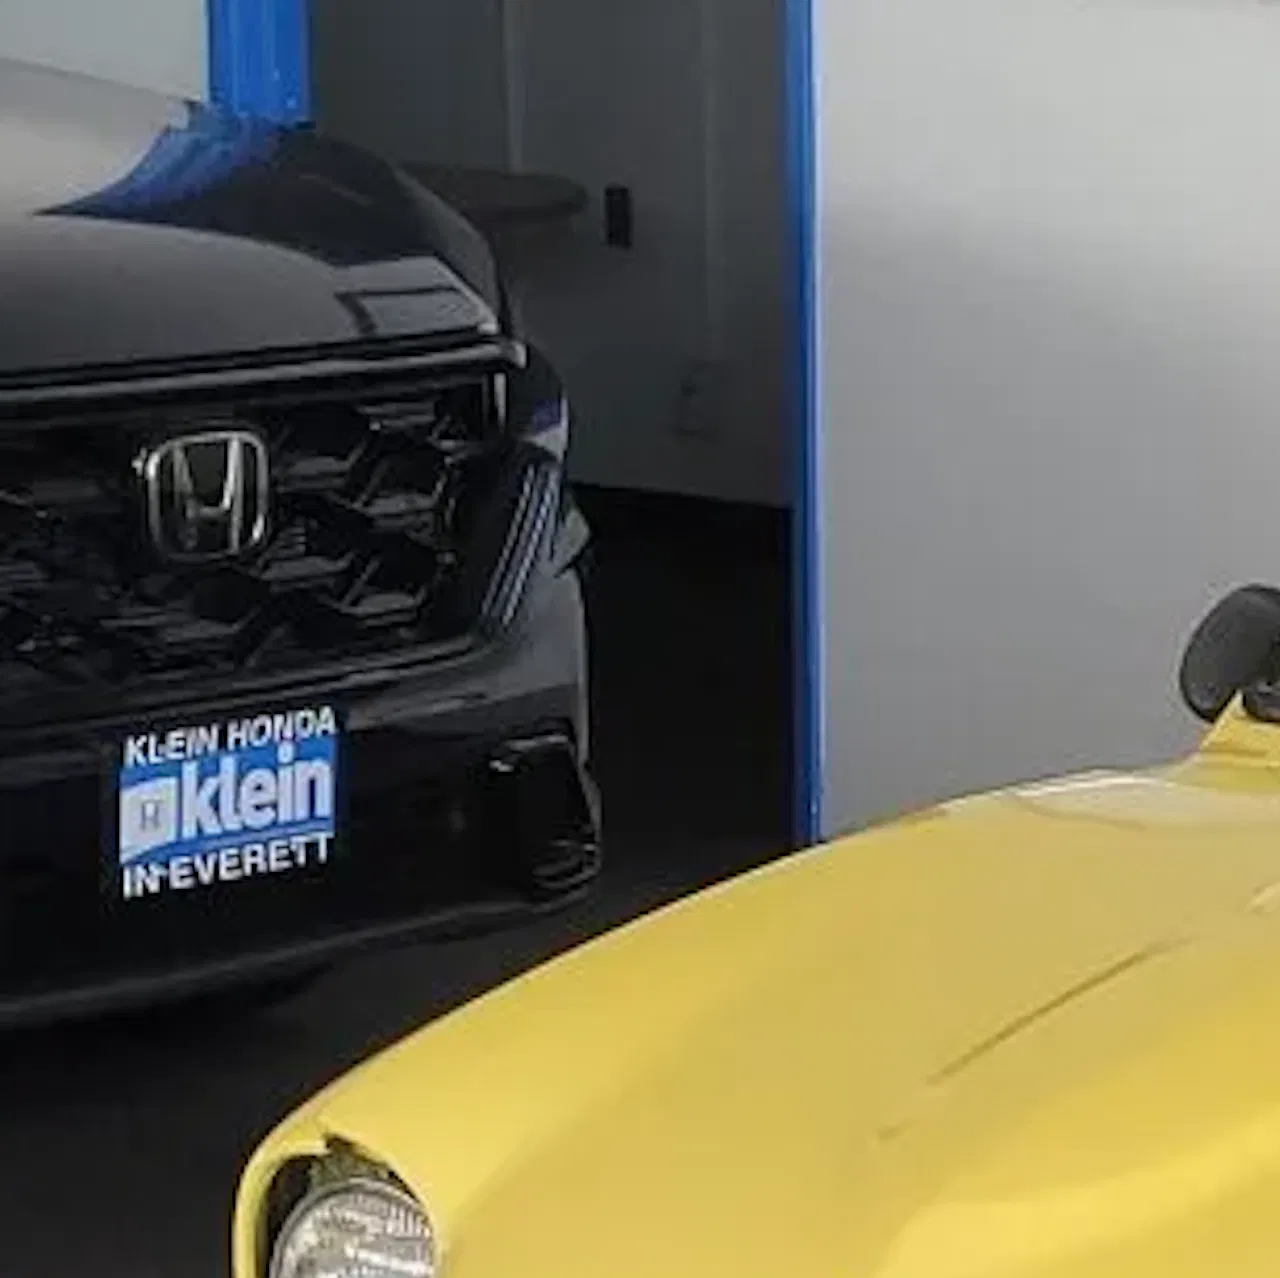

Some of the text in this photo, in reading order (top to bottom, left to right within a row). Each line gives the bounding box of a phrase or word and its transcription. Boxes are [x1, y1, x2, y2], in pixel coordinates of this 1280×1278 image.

[126, 705, 336, 766] KLEIN HONDA
[182, 743, 331, 841] klein
[123, 832, 335, 899] IN EVERETT
